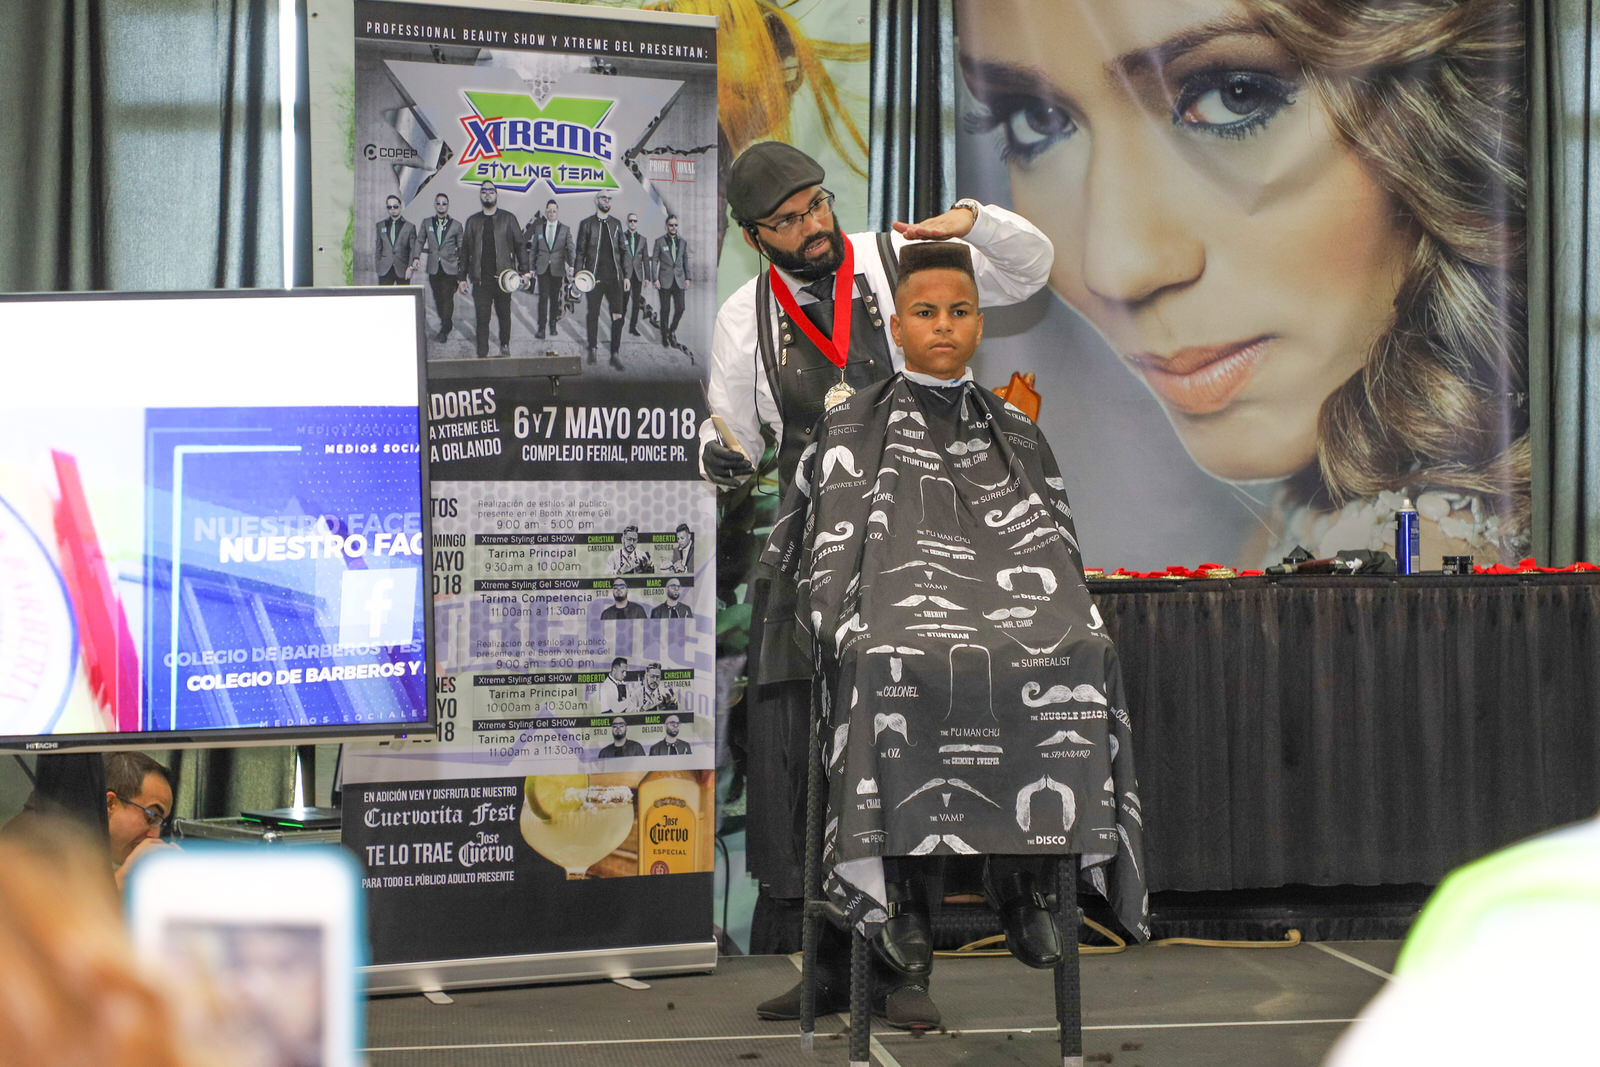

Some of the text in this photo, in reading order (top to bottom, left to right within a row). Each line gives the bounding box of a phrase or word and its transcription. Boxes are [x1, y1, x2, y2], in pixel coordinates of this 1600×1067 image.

[367, 22, 709, 59] PROFESSIONAL BEAUTY SHOW Y XTREME GEL PRESENTAN:
[458, 115, 612, 164] XTREME
[380, 147, 418, 158] COPEP
[477, 160, 604, 181] STYLING TEAM
[429, 418, 500, 440] A XTREME GEL
[565, 406, 631, 439] MAYO
[637, 407, 696, 440] 2018
[828, 425, 857, 438] PENCIL
[902, 428, 926, 440] SHERIFF
[325, 443, 377, 454] MEDIOS
[1008, 434, 1035, 450] PENCIL
[430, 437, 502, 463] A ORLANDO
[522, 444, 688, 464] COMPLEJO FERIAL, PONCE PR.
[902, 454, 940, 471] STUNTMAN
[826, 481, 853, 493] PRIVATE
[430, 498, 458, 518] TOS
[526, 499, 536, 508] de
[539, 499, 565, 508] estilos
[568, 499, 576, 508] al
[566, 509, 595, 518] Xtreme
[524, 520, 540, 530] am
[578, 519, 595, 530] pm
[481, 534, 576, 545] Xtreme Styling Gel SHOW
[869, 531, 884, 541] OZ
[219, 533, 368, 563] NUESTRO
[488, 548, 577, 560] Tarima Principal
[481, 579, 580, 592] Xtreme Styling Gel SHOW
[923, 582, 948, 591] VAMP
[480, 591, 593, 605] Tarima Competencia
[1020, 593, 1051, 602] DISCO
[923, 610, 948, 619] SHERIFF
[1016, 619, 1033, 628] CHIP
[926, 632, 970, 640] STUNTMAN
[163, 649, 248, 667] COLEGIO
[252, 646, 277, 662] DE
[1021, 656, 1071, 668] SURREALIST
[186, 661, 421, 692] COLEGIO DE BARBEROS Y
[479, 674, 573, 686] Xtreme Styling Gel SHOW
[577, 674, 606, 683] ROBERTO
[489, 687, 577, 700] Tarima Principal
[883, 685, 919, 698] COLONEL
[478, 718, 577, 731] Xtreme Styling Gel SHOW
[963, 728, 981, 737] MAN
[982, 727, 1000, 737] CHU
[26, 741, 59, 750] HITACHI
[478, 732, 590, 746] Tarima Competencia
[887, 747, 901, 758] OZ
[364, 786, 517, 803] EN ADICIÓN VEN Y DISFRUTA DE NUESTRO
[364, 802, 516, 828] Cuervorita Fest
[663, 814, 678, 827] Jose
[939, 812, 965, 821] VAMP
[649, 822, 689, 845] Cuervo
[1035, 835, 1067, 845] DISCO
[365, 840, 514, 868] TE LO TRAE Cuervo
[653, 848, 687, 856] ESPECIAL
[361, 870, 515, 889] PARA TODO EL PÚBLICO ADULTO PRESENTE
